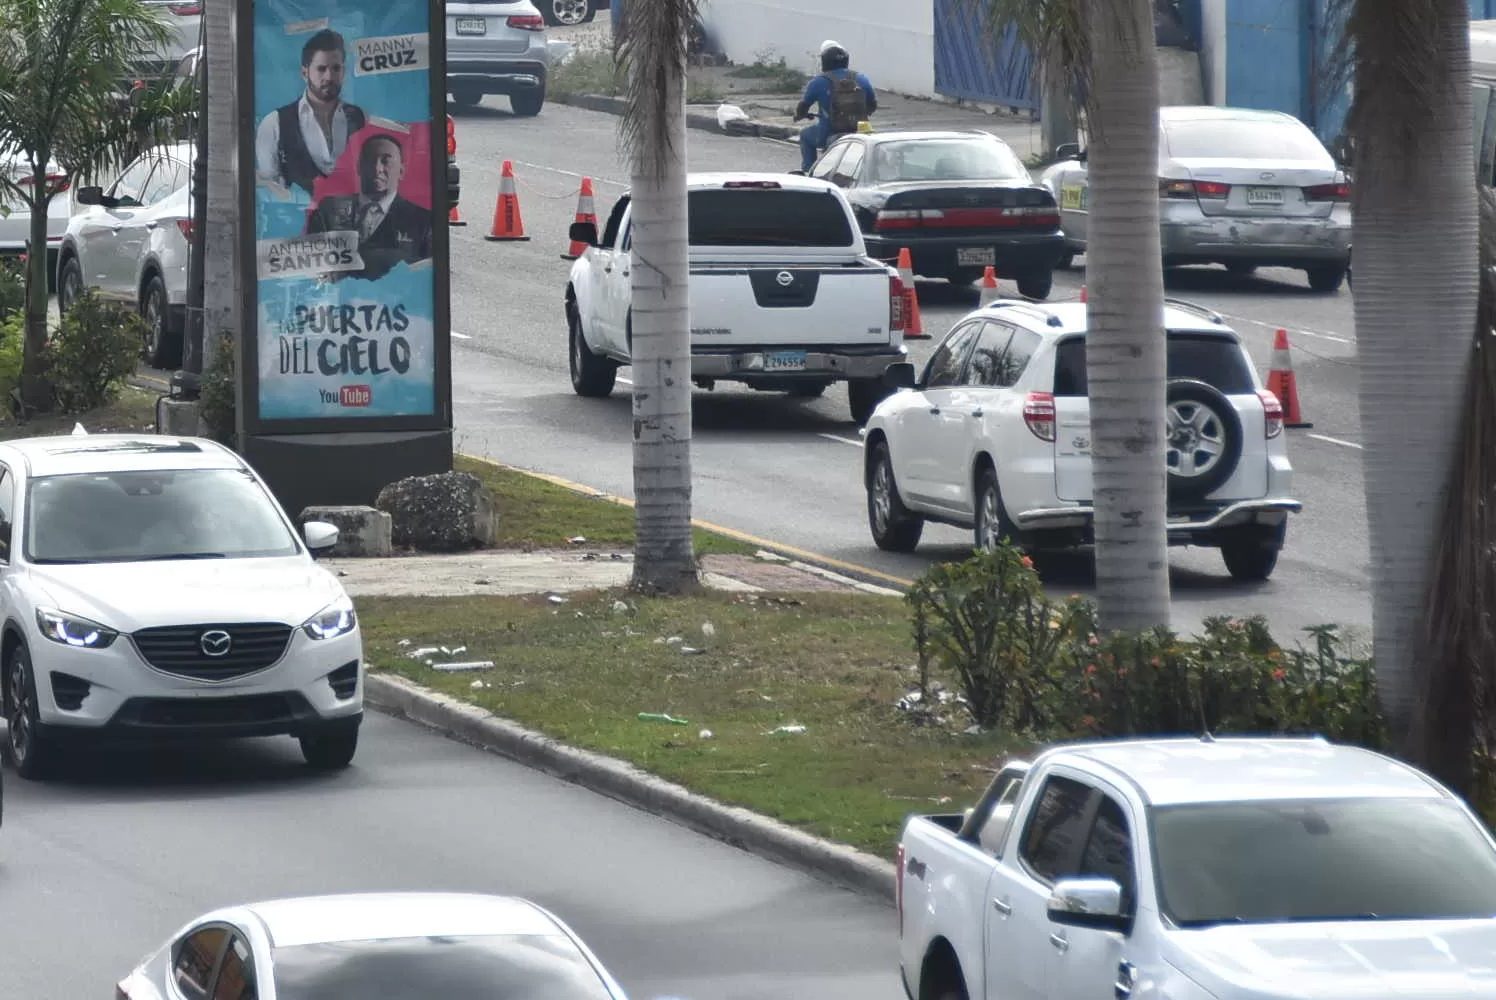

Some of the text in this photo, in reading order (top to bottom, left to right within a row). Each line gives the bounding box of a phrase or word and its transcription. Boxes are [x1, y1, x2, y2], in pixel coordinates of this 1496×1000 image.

[358, 36, 416, 57] MANNY
[360, 49, 418, 72] CRUZ
[269, 236, 350, 257] ANTHONY
[269, 249, 354, 273] SANTOS
[295, 303, 410, 336] PUERTAS
[279, 335, 412, 377] DEL CIELO
[319, 384, 372, 407] YouTube
